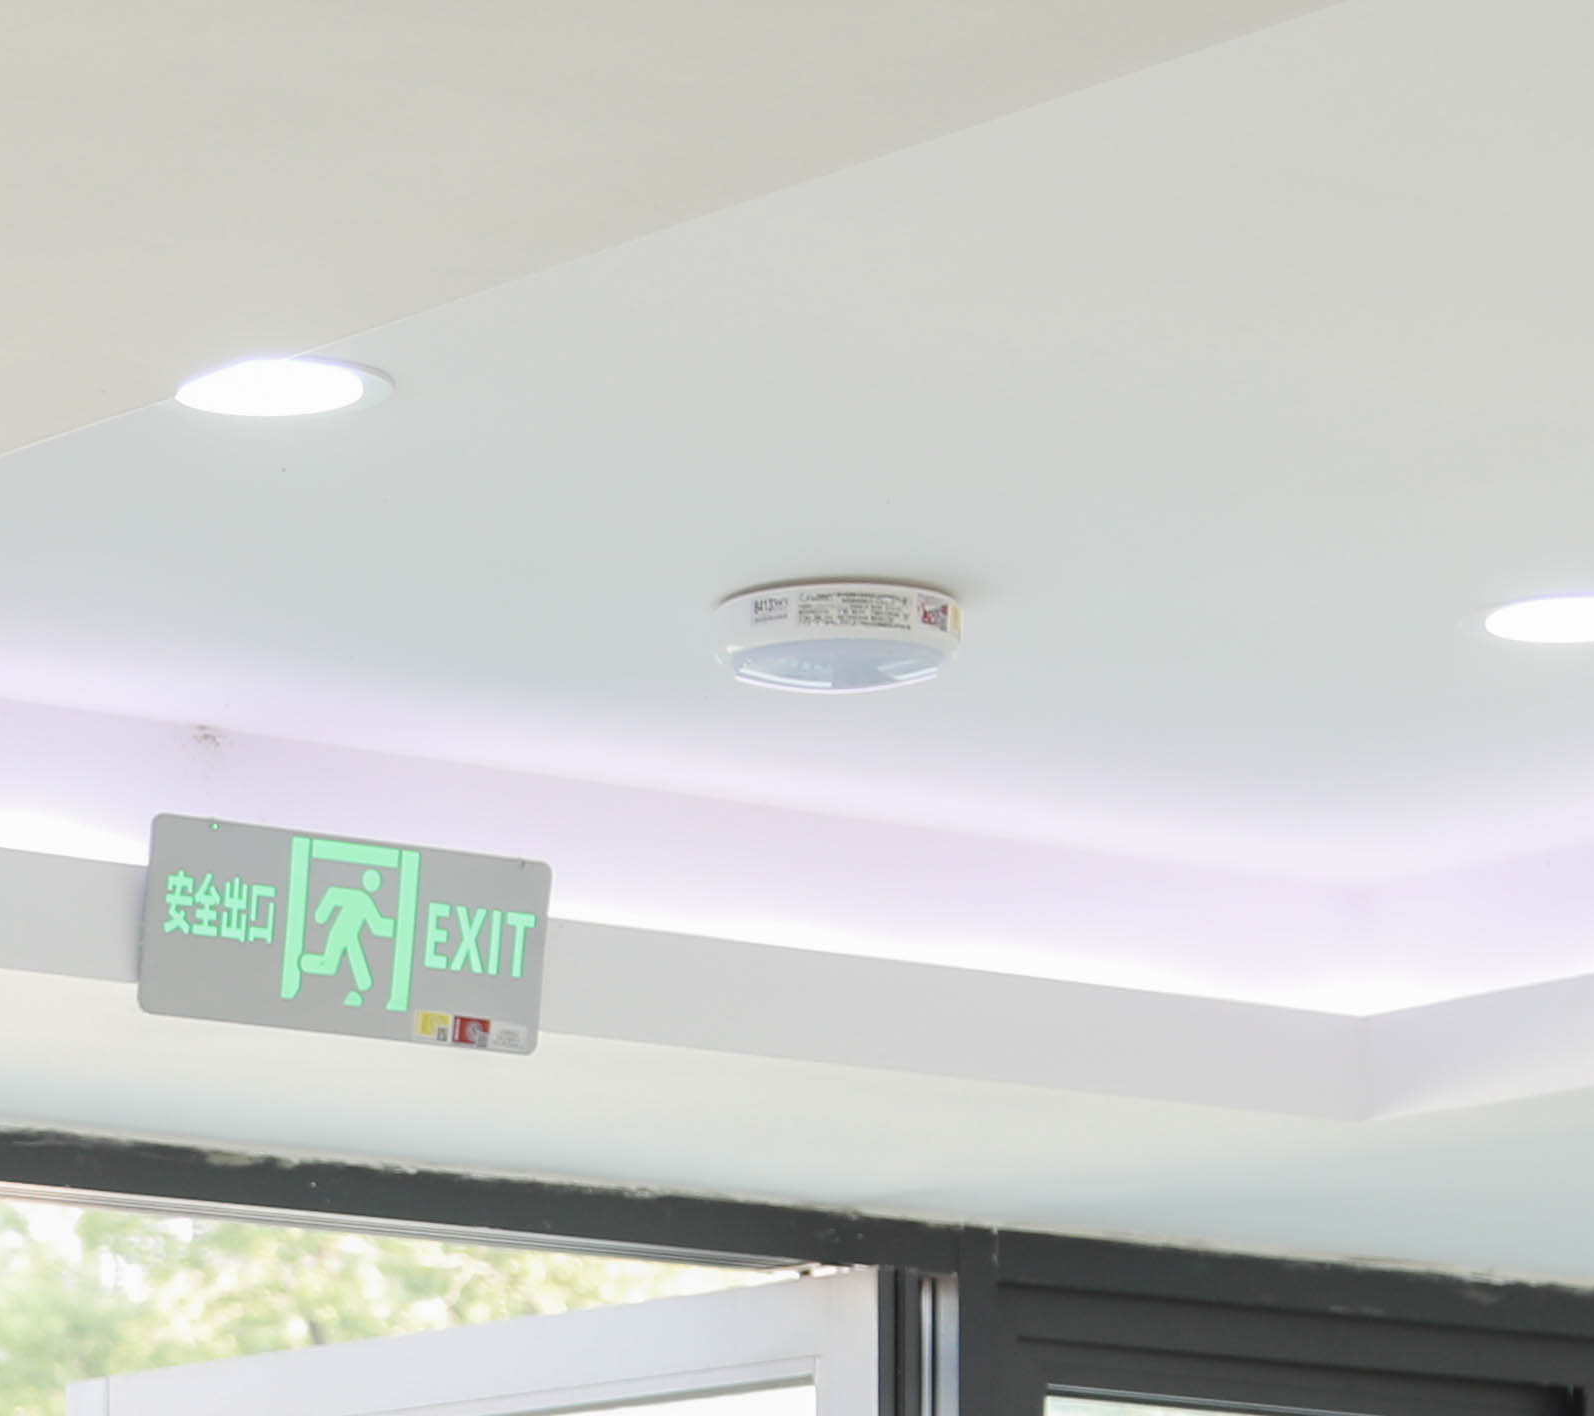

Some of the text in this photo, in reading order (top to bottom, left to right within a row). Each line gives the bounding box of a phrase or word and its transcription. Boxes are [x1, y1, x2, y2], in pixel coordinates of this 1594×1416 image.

[161, 869, 278, 945] 安全出口
[423, 902, 537, 978] EXIT
